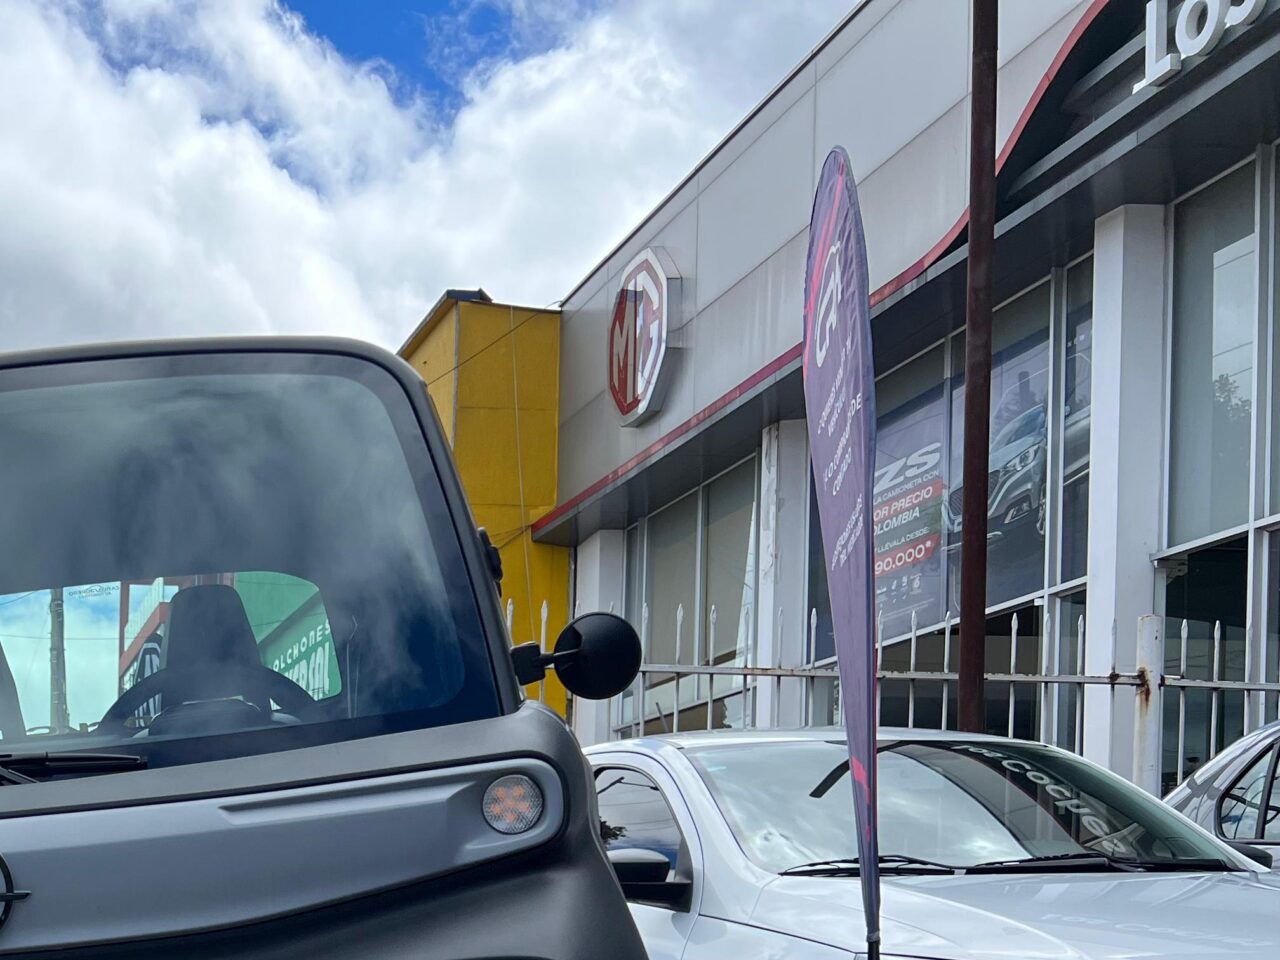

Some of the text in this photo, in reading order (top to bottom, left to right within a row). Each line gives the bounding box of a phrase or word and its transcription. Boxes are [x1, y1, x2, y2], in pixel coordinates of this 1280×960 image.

[611, 266, 662, 406] MG
[873, 442, 942, 496] ZS
[882, 477, 922, 500] CAMIONETA
[923, 470, 939, 482] CON
[873, 486, 933, 522] OR PRECIO
[873, 506, 920, 536] LOMBIA
[272, 618, 331, 673] OLCHONES
